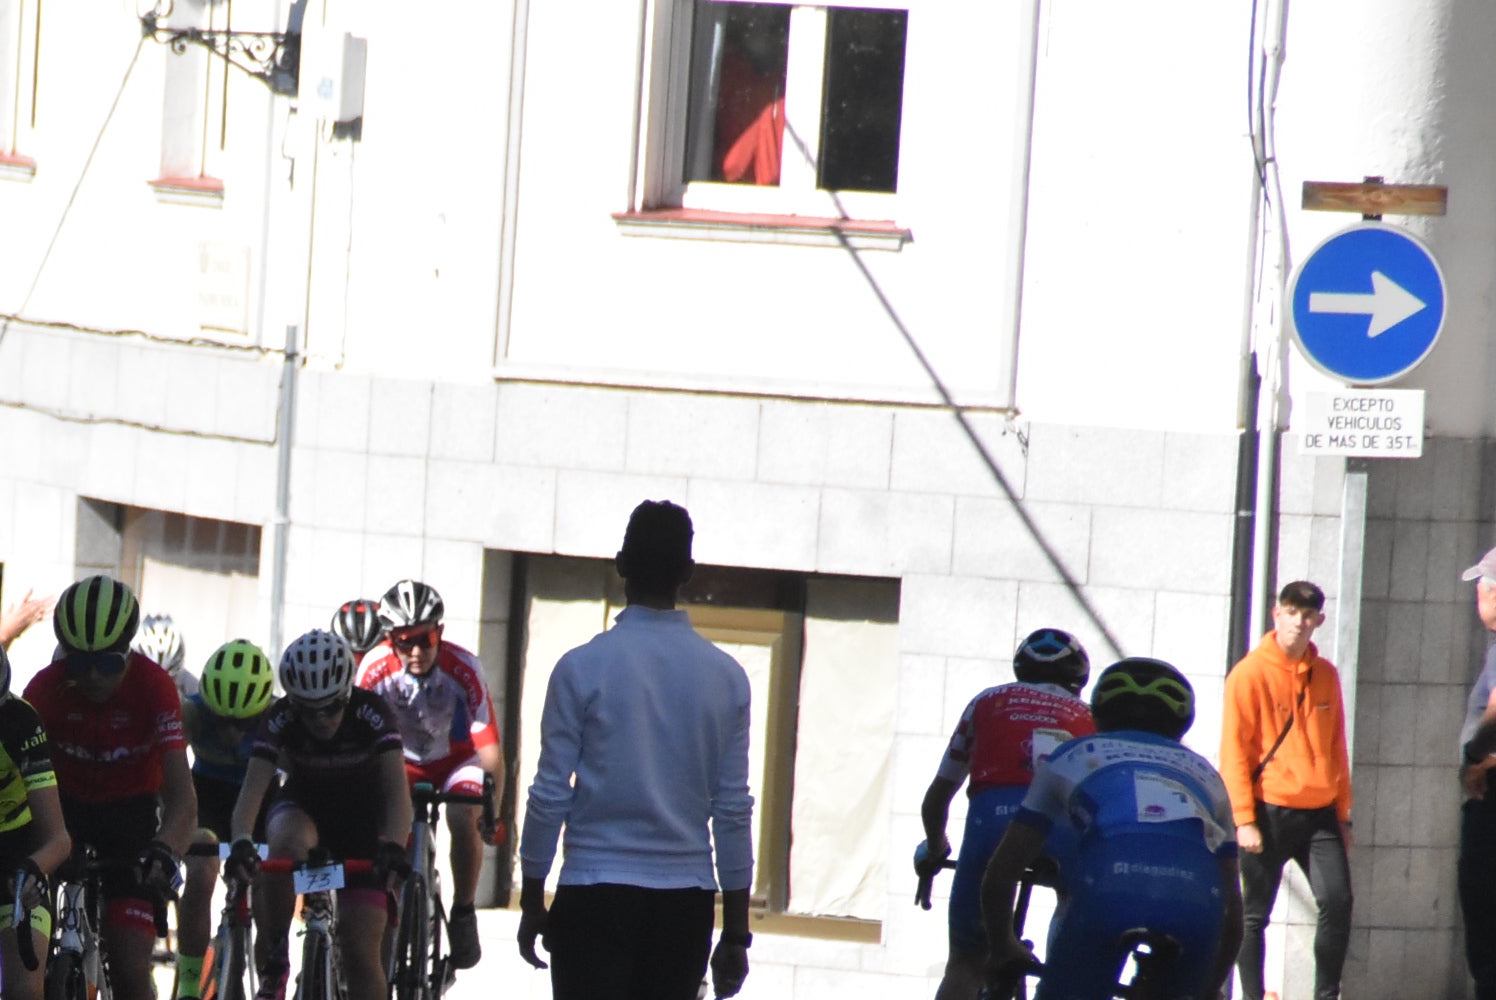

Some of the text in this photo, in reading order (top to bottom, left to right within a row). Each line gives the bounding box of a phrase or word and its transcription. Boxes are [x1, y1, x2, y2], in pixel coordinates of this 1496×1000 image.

[1333, 397, 1394, 412] EXCEPTO
[1327, 415, 1402, 431] VEHICULOS
[1305, 434, 1323, 449] DE
[1328, 434, 1357, 449] MAS
[1362, 435, 1380, 449] DE
